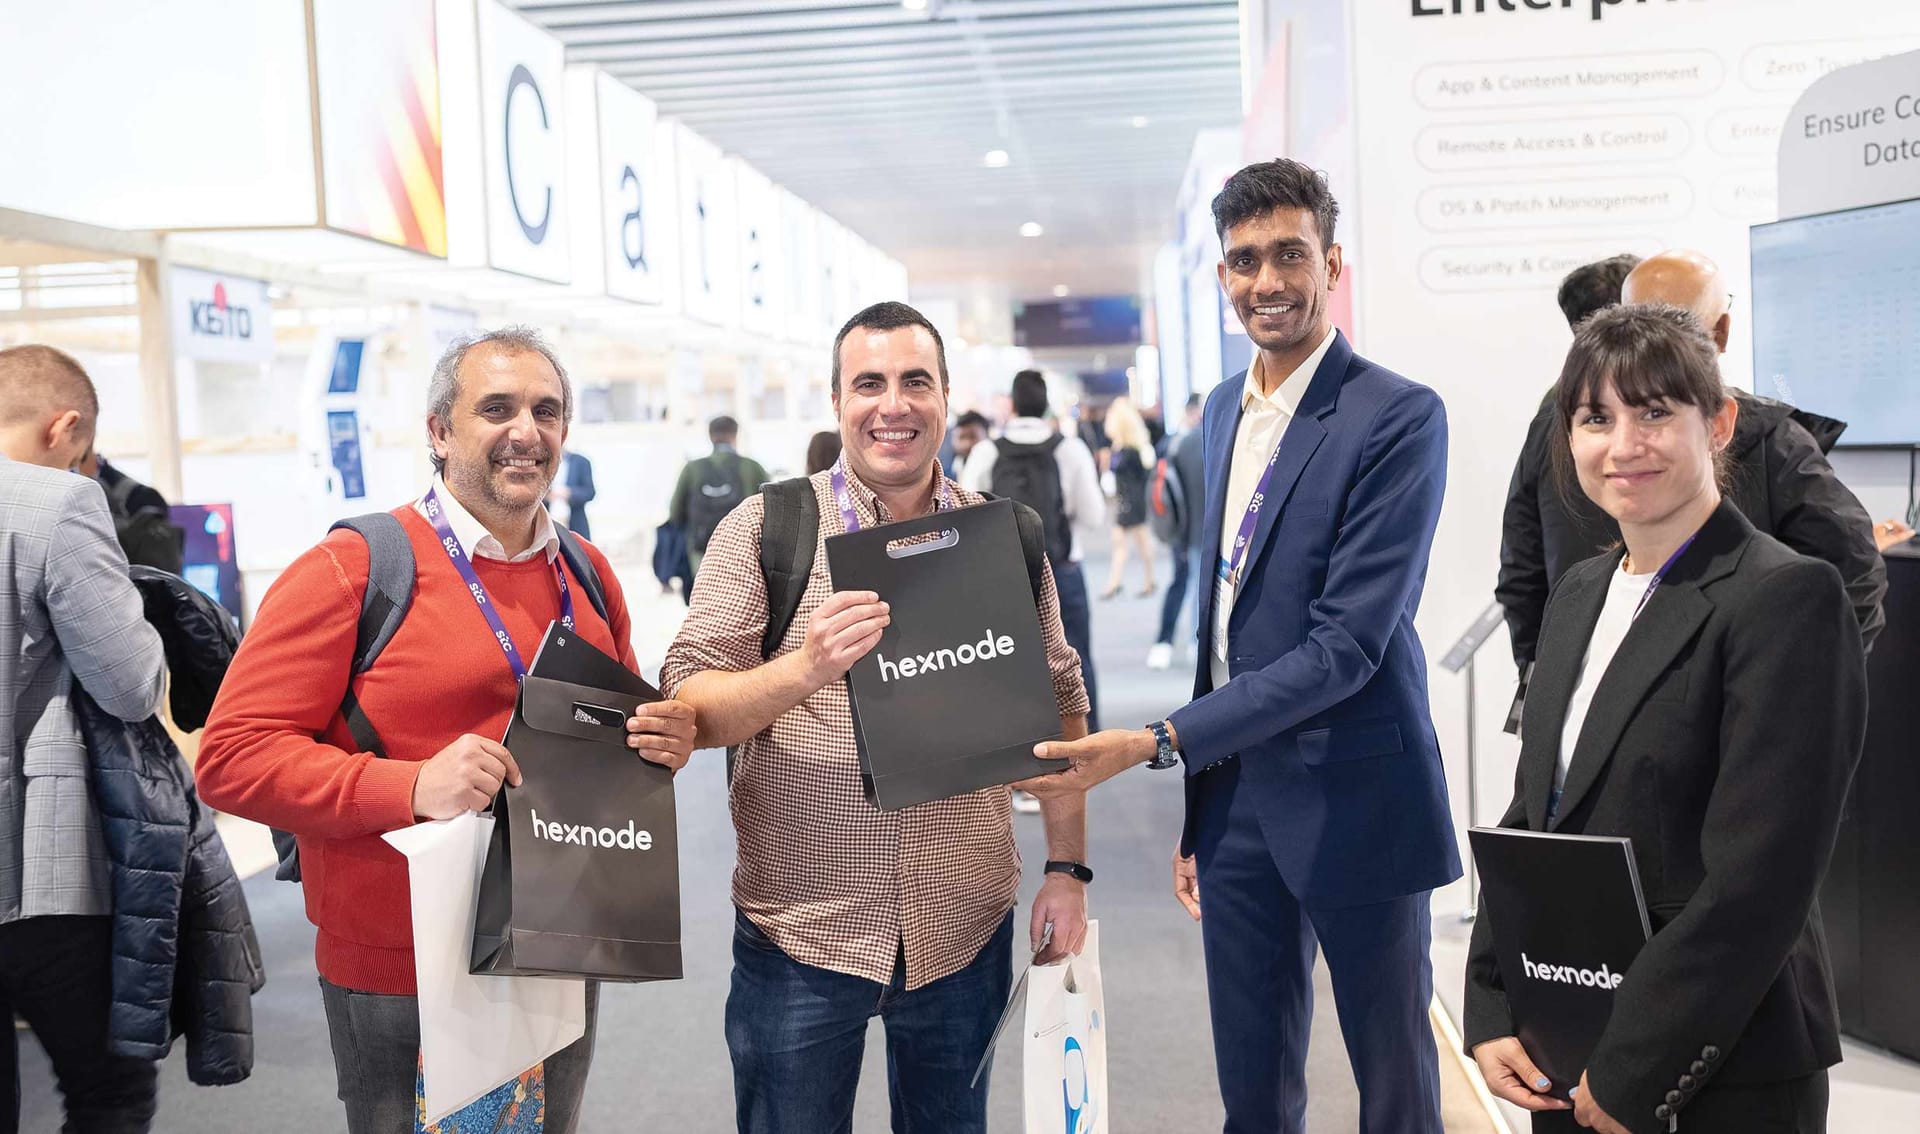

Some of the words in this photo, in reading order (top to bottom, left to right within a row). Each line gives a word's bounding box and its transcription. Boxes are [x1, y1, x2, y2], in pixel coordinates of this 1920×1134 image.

[1437, 77, 1475, 96] App
[1499, 72, 1570, 91] Content
[1576, 65, 1700, 87] Management
[1803, 104, 1885, 138] Ensure
[1437, 138, 1507, 156] Remote
[1512, 135, 1577, 151] Access
[1600, 127, 1669, 146] Control
[1439, 200, 1467, 217] OS
[1490, 194, 1544, 212] Patch
[1548, 191, 1670, 211] Management
[1441, 259, 1513, 278] Security
[426, 498, 439, 517] stc
[1248, 491, 1264, 514] stc
[443, 536, 460, 558] stc
[469, 582, 486, 605] stc
[495, 629, 512, 652] stc
[877, 629, 1015, 683] hexnode
[530, 809, 653, 851] hexnode
